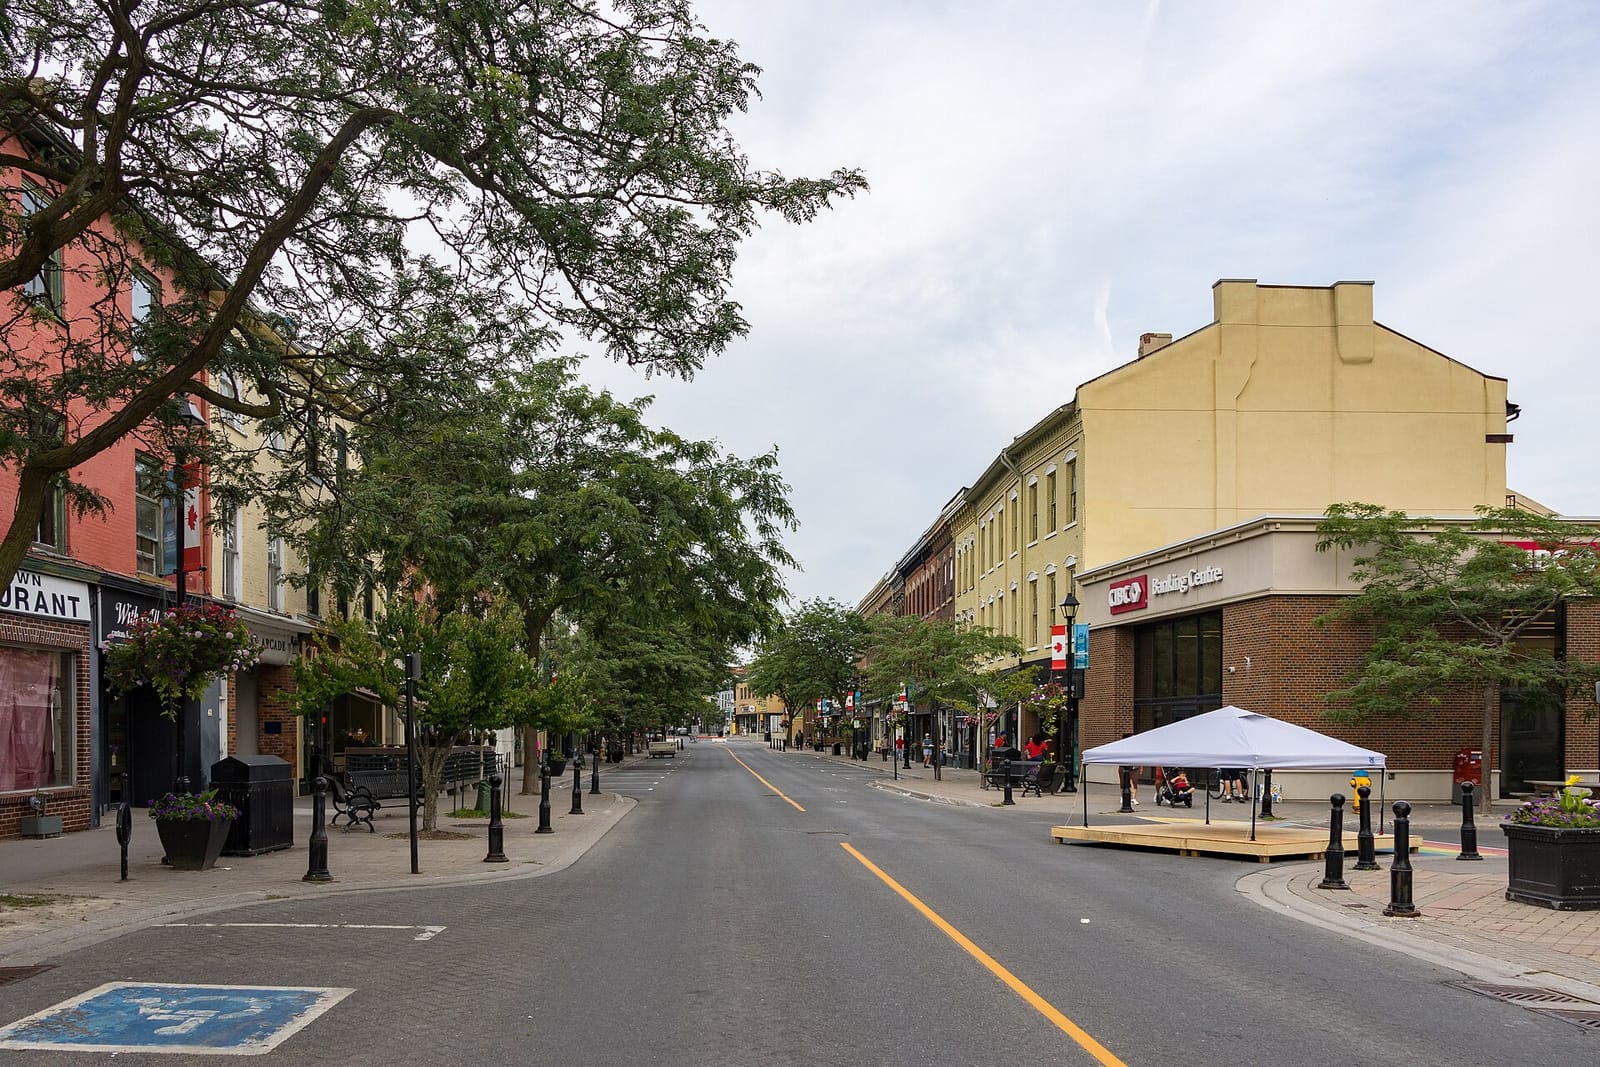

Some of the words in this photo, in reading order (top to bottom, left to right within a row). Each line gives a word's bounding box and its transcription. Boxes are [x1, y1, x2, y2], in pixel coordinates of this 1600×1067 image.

[1108, 584, 1132, 607] CIBC
[1151, 573, 1188, 594] Banking
[1188, 567, 1223, 587] Centre
